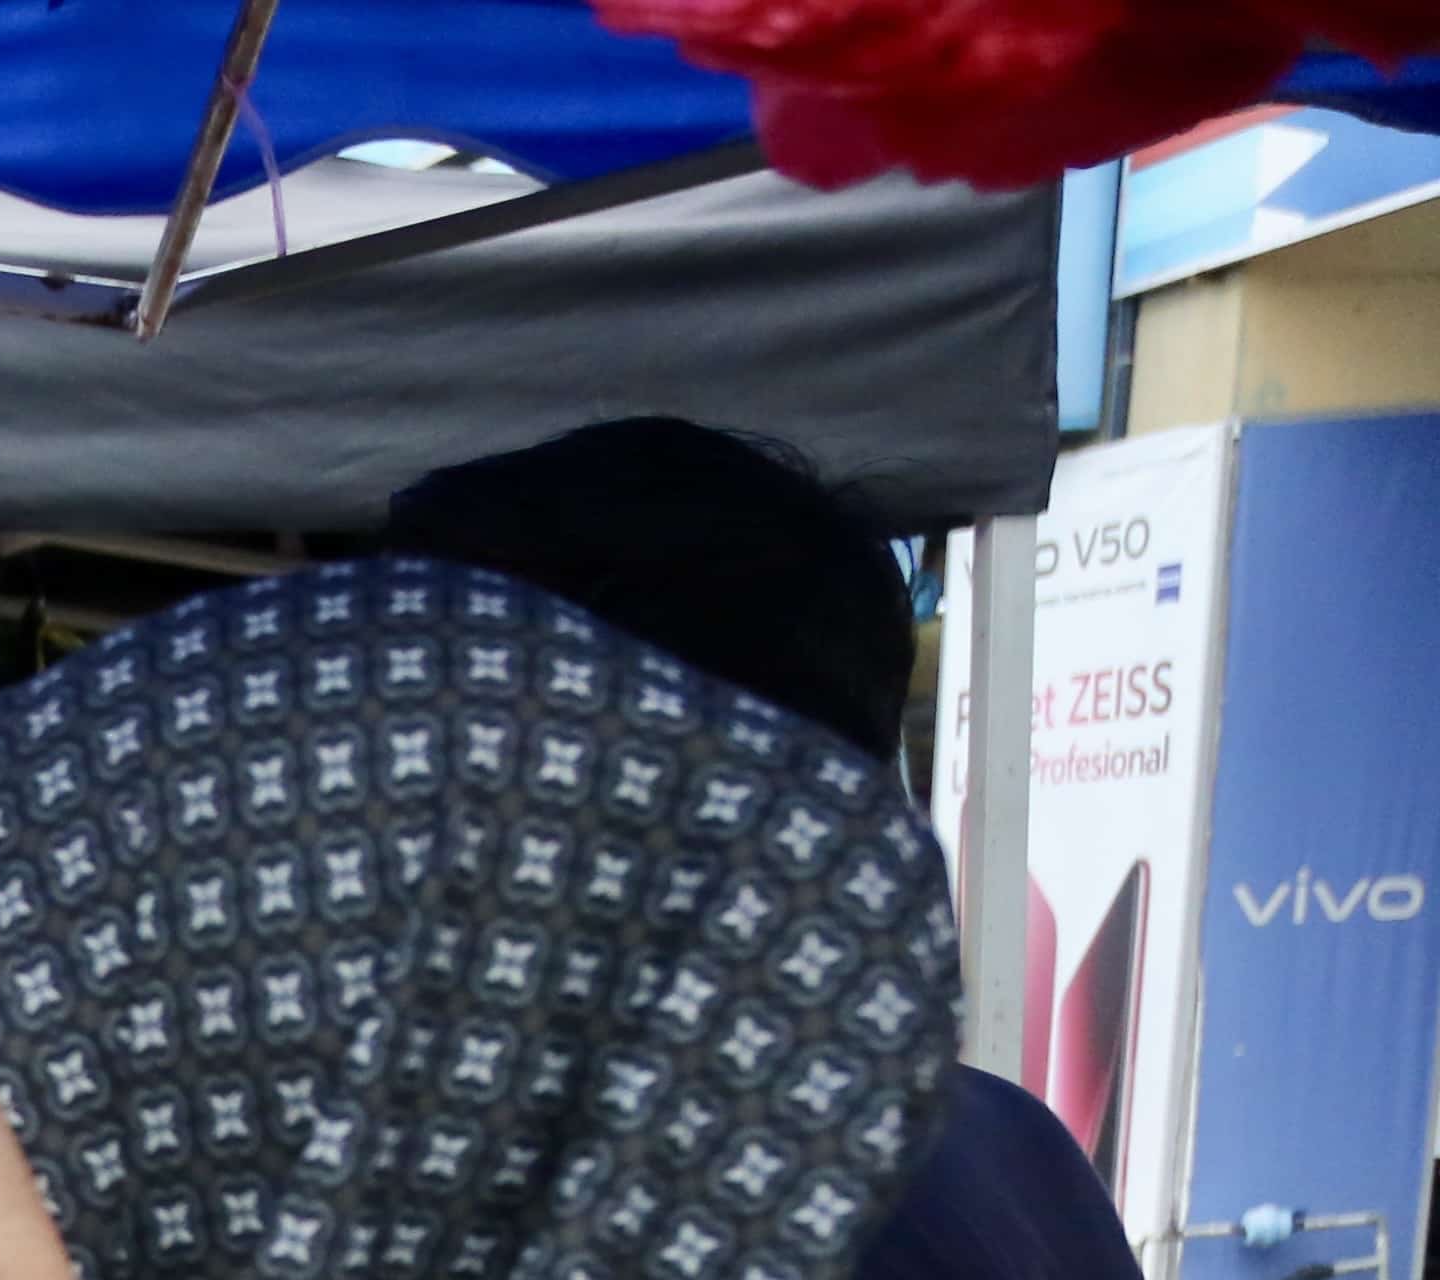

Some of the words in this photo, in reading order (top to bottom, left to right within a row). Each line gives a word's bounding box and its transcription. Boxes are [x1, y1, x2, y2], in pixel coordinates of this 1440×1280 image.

[1073, 517, 1152, 570] V50
[1067, 661, 1174, 727] ZEISS
[1231, 863, 1425, 928] vivo
